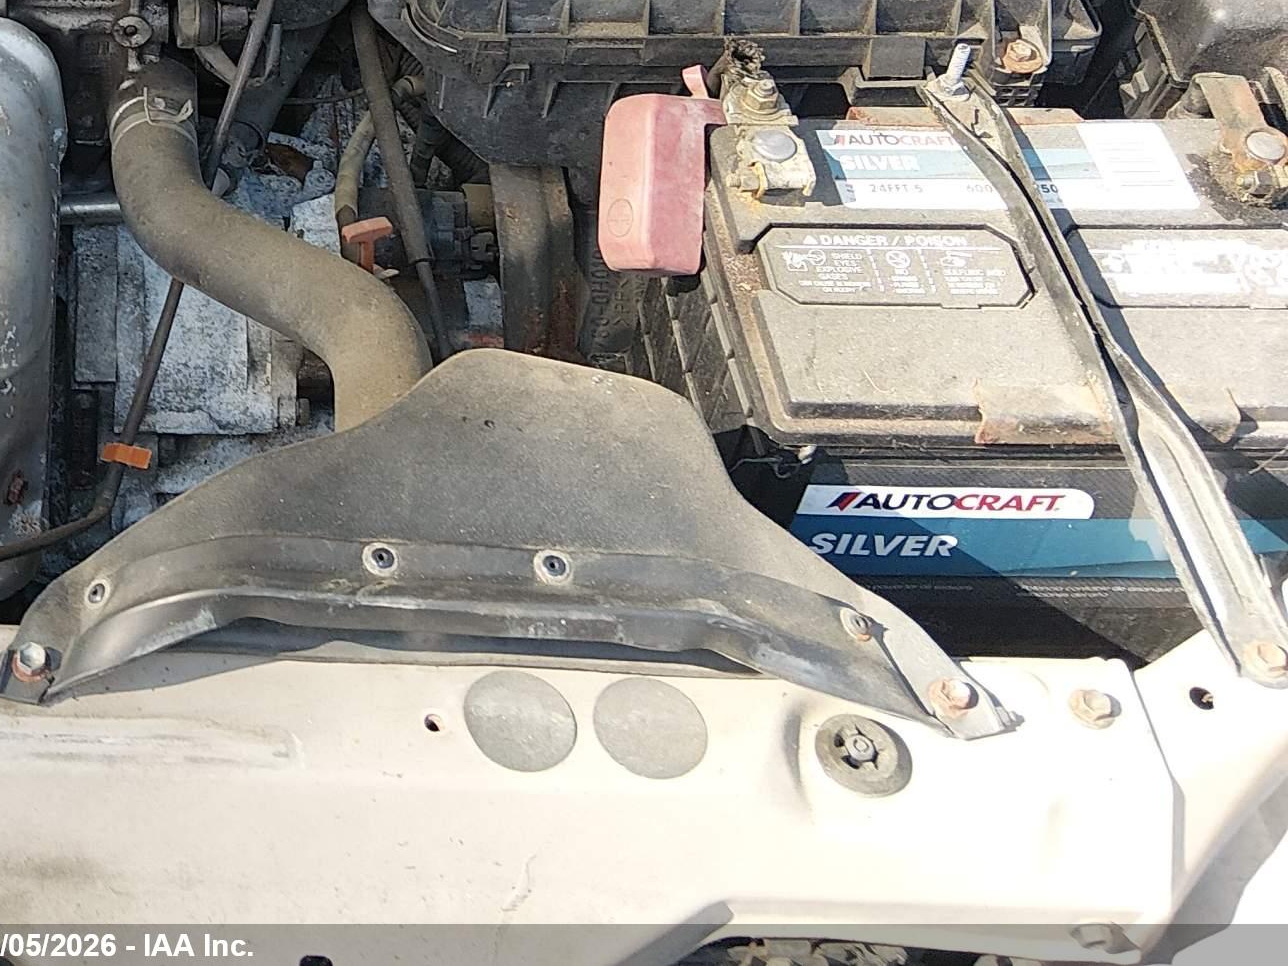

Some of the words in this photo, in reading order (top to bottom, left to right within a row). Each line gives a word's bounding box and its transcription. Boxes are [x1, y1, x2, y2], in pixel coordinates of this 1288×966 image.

[840, 154, 920, 172] SILVER
[820, 235, 888, 246] DANGER
[905, 236, 968, 246] POISON
[854, 493, 1065, 512] AUTOCRAFT
[808, 533, 958, 557] SILVER
